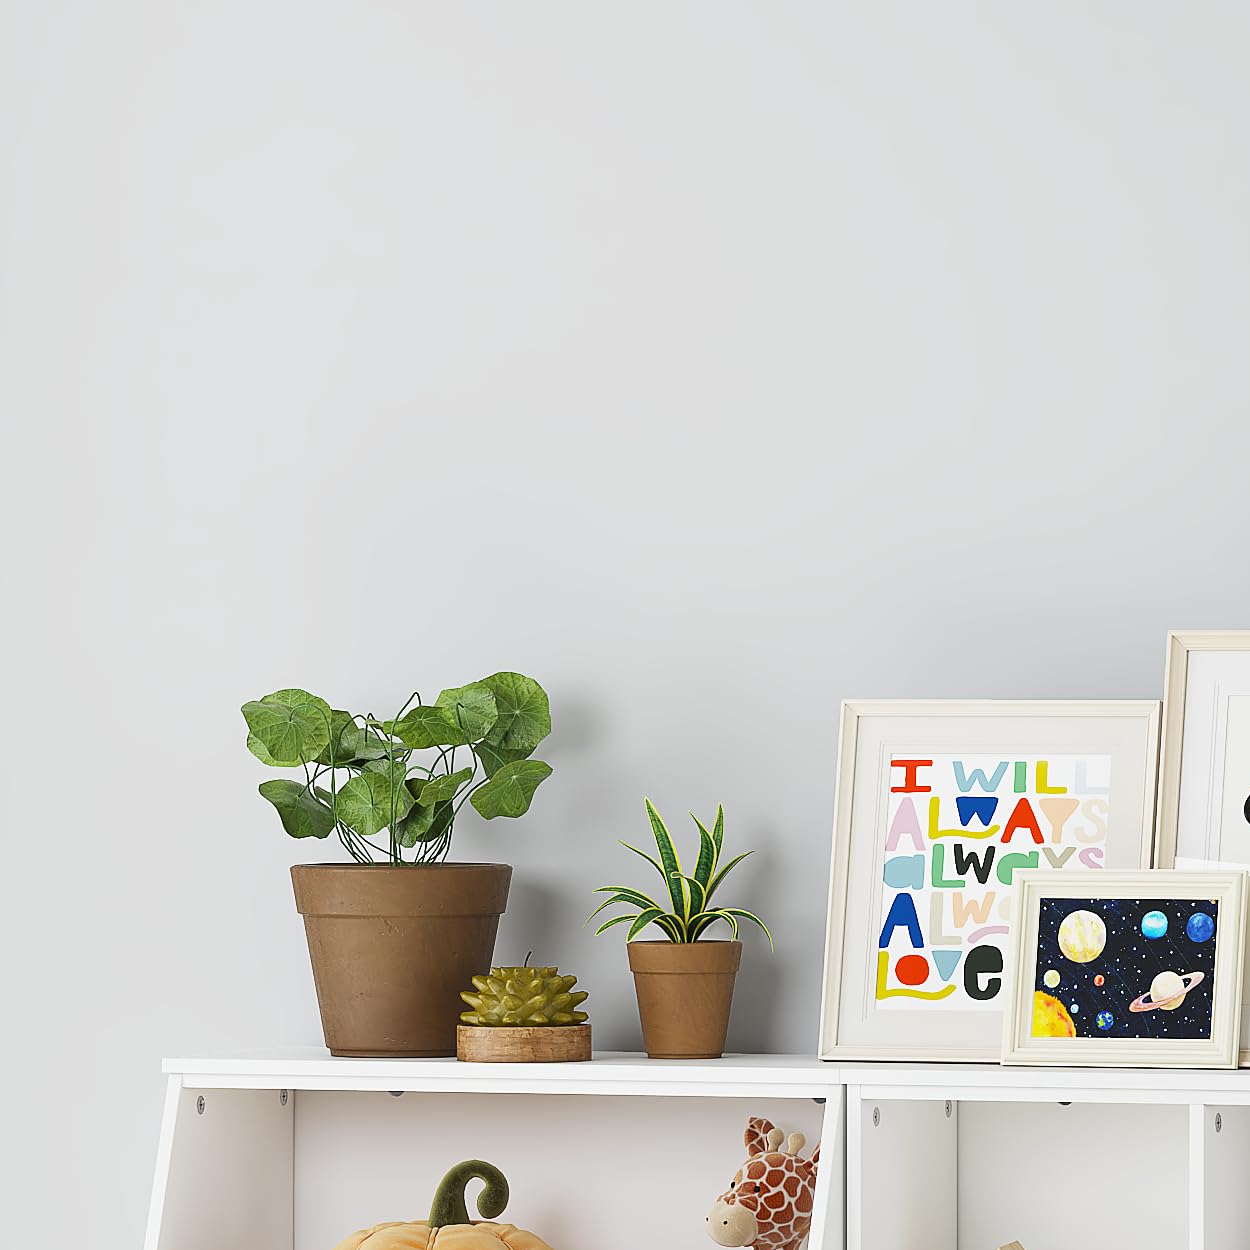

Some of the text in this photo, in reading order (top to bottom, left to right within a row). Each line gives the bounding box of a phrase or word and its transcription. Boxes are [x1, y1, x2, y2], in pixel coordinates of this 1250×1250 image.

[890, 759, 1109, 794] I WILL
[885, 797, 1107, 852] ALWAYS
